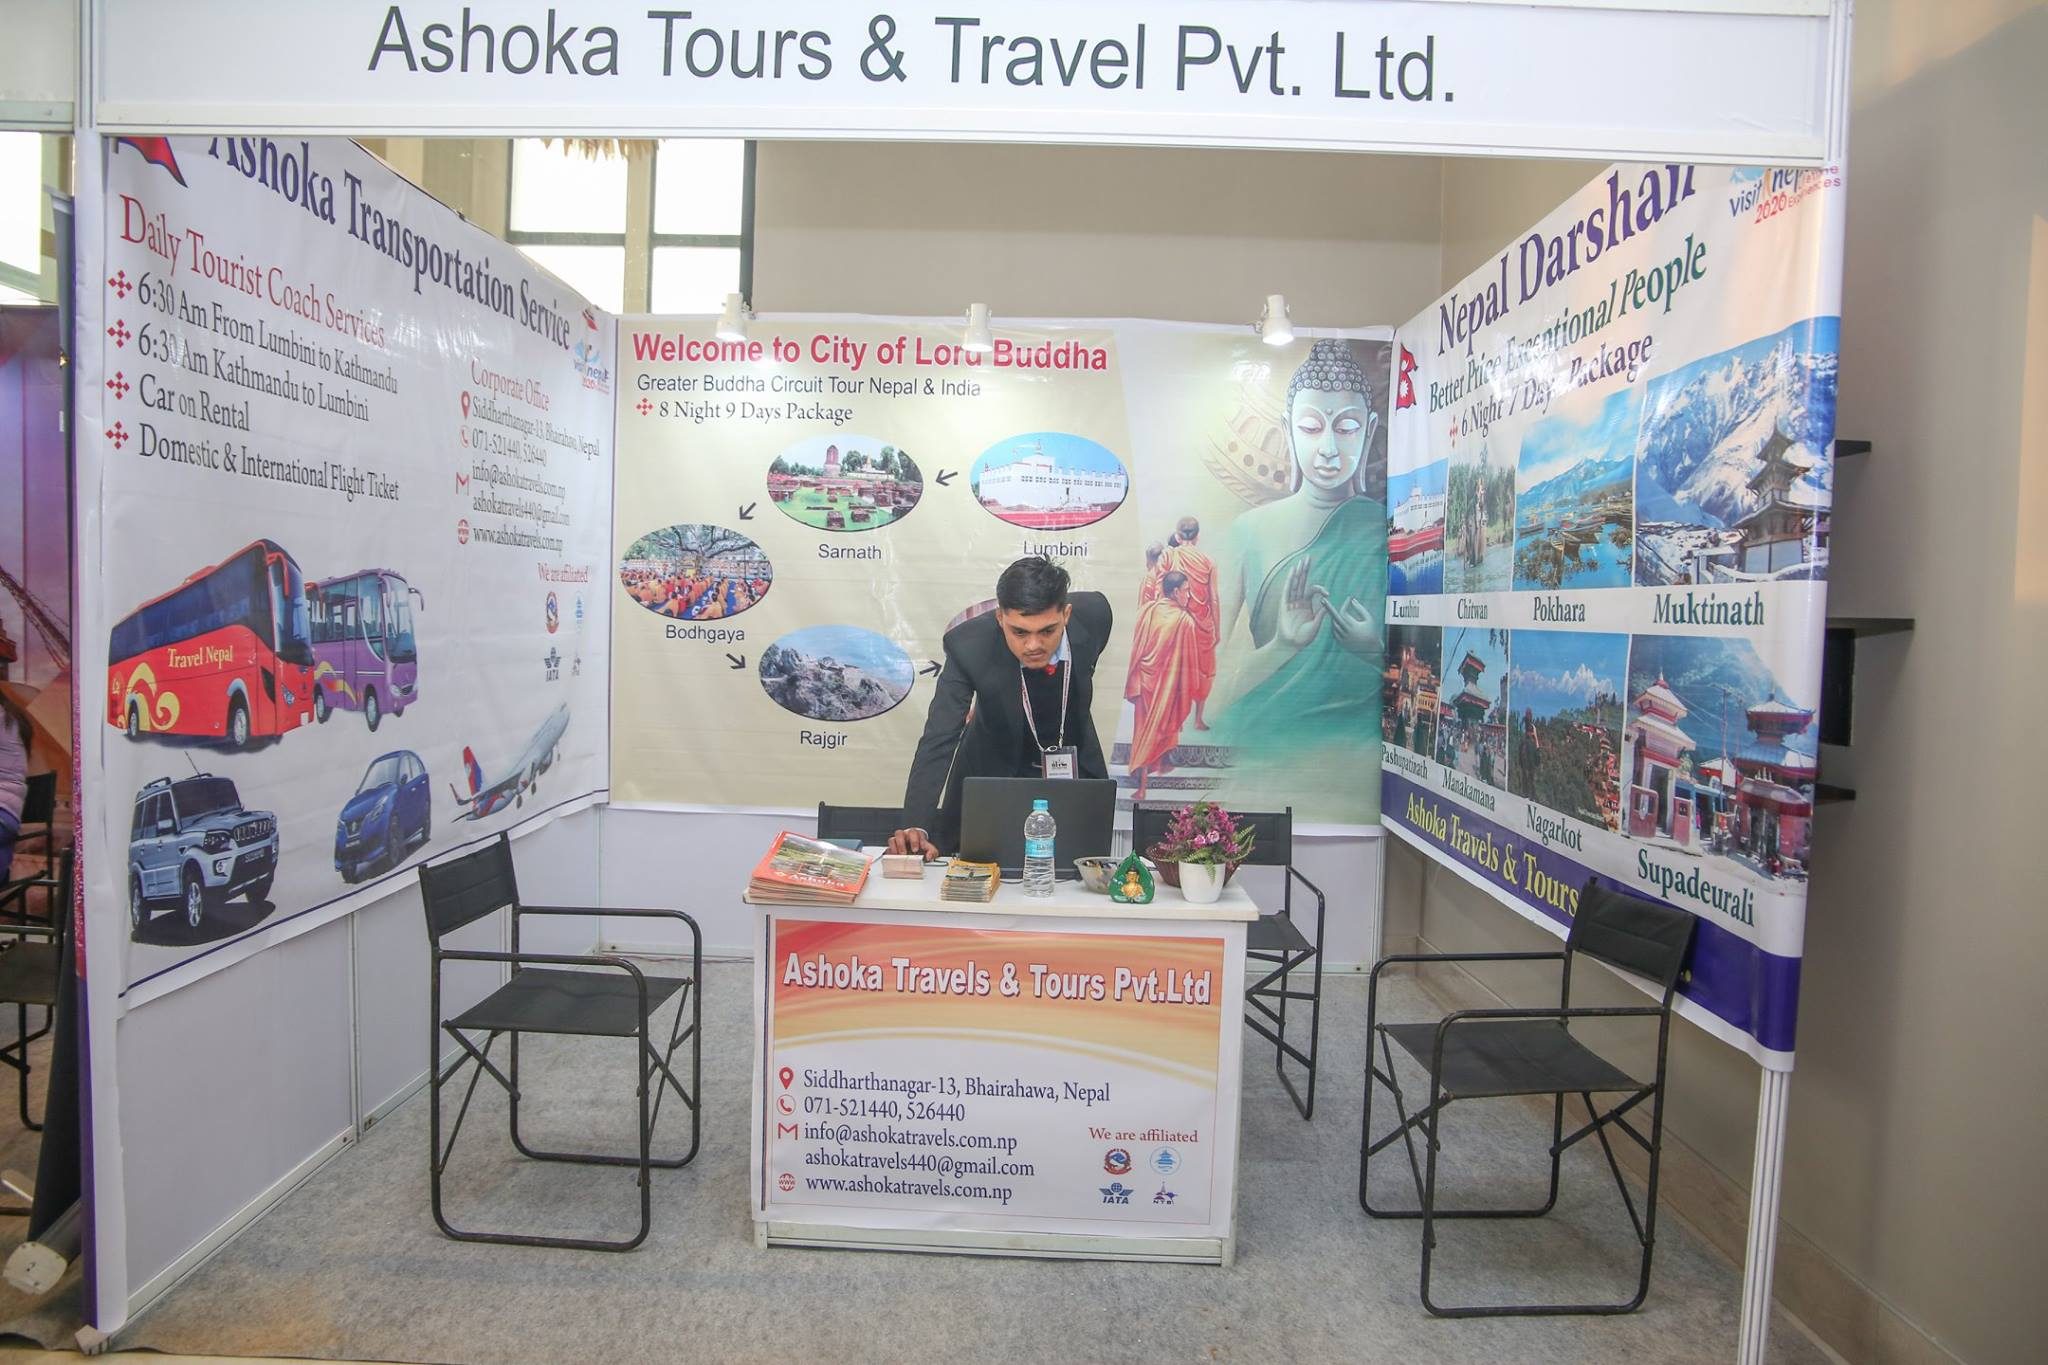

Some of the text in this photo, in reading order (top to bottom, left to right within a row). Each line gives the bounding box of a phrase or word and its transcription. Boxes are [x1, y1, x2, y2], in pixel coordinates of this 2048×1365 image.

[368, 6, 1454, 102] Ashoka Tours & Travel Pvt. Ltd.
[1729, 179, 1763, 217] visit
[1754, 191, 1788, 224] 2020
[119, 194, 385, 349] Daily Tourist Coach Services
[344, 169, 515, 319] Transportation
[520, 278, 570, 350] Service
[1437, 252, 1509, 356] Nepal
[139, 271, 398, 394] 6:30 Am From Lumbini to Kathmandu
[1430, 381, 1464, 414] Better
[1466, 352, 1501, 394] Price
[1618, 232, 1707, 319] People
[632, 332, 763, 362] Welcome
[772, 335, 801, 363] to
[810, 334, 867, 371] City
[876, 336, 907, 365] of
[993, 339, 1108, 370] Buddha
[139, 322, 369, 422] 6:30 Am Kathmandu to Lumbini
[471, 357, 523, 400] Corporate
[637, 374, 981, 398] Greater Buddha Circuit Tour Nepal & India
[1462, 409, 1469, 438] 6
[1470, 397, 1504, 438] Night
[1521, 378, 1554, 415] Day
[1569, 335, 1653, 388] Package
[139, 373, 250, 431] Car on Rental
[659, 401, 853, 426] 8 Night 9 Days Package
[139, 422, 399, 502] Domestic & International Flight Ticket
[818, 544, 882, 560] Sarnath
[1023, 541, 1088, 556] Lumbini
[1457, 598, 1488, 620] Chitwan
[1533, 596, 1586, 622] Pokhara
[1653, 589, 1765, 625] Muktinath
[665, 625, 745, 643] Bodhgaya
[168, 645, 233, 670] Travel Nepal
[800, 730, 848, 749] Rajgir
[1442, 768, 1495, 811] Manakamana
[1526, 804, 1583, 852] Nagarkot
[1406, 792, 1580, 918] Ashoka Travels & Tours
[1637, 848, 1755, 928] Supadeurali
[783, 952, 1211, 1005] Ashoka Travels & Tours Pvt.Ltd
[804, 1069, 1111, 1106] Siddharthanagar-13, Bhairahawa, Nepal
[804, 1096, 965, 1122] 071-521440, 526440
[804, 1121, 1017, 1155] info@ashokatravels.com.np
[1088, 1127, 1198, 1143] We are affiliated
[805, 1147, 1034, 1178] ashokatravels440@gmail.com
[806, 1175, 1012, 1205] www.ashokatravels.com.np
[1102, 1196, 1129, 1205] IATA
